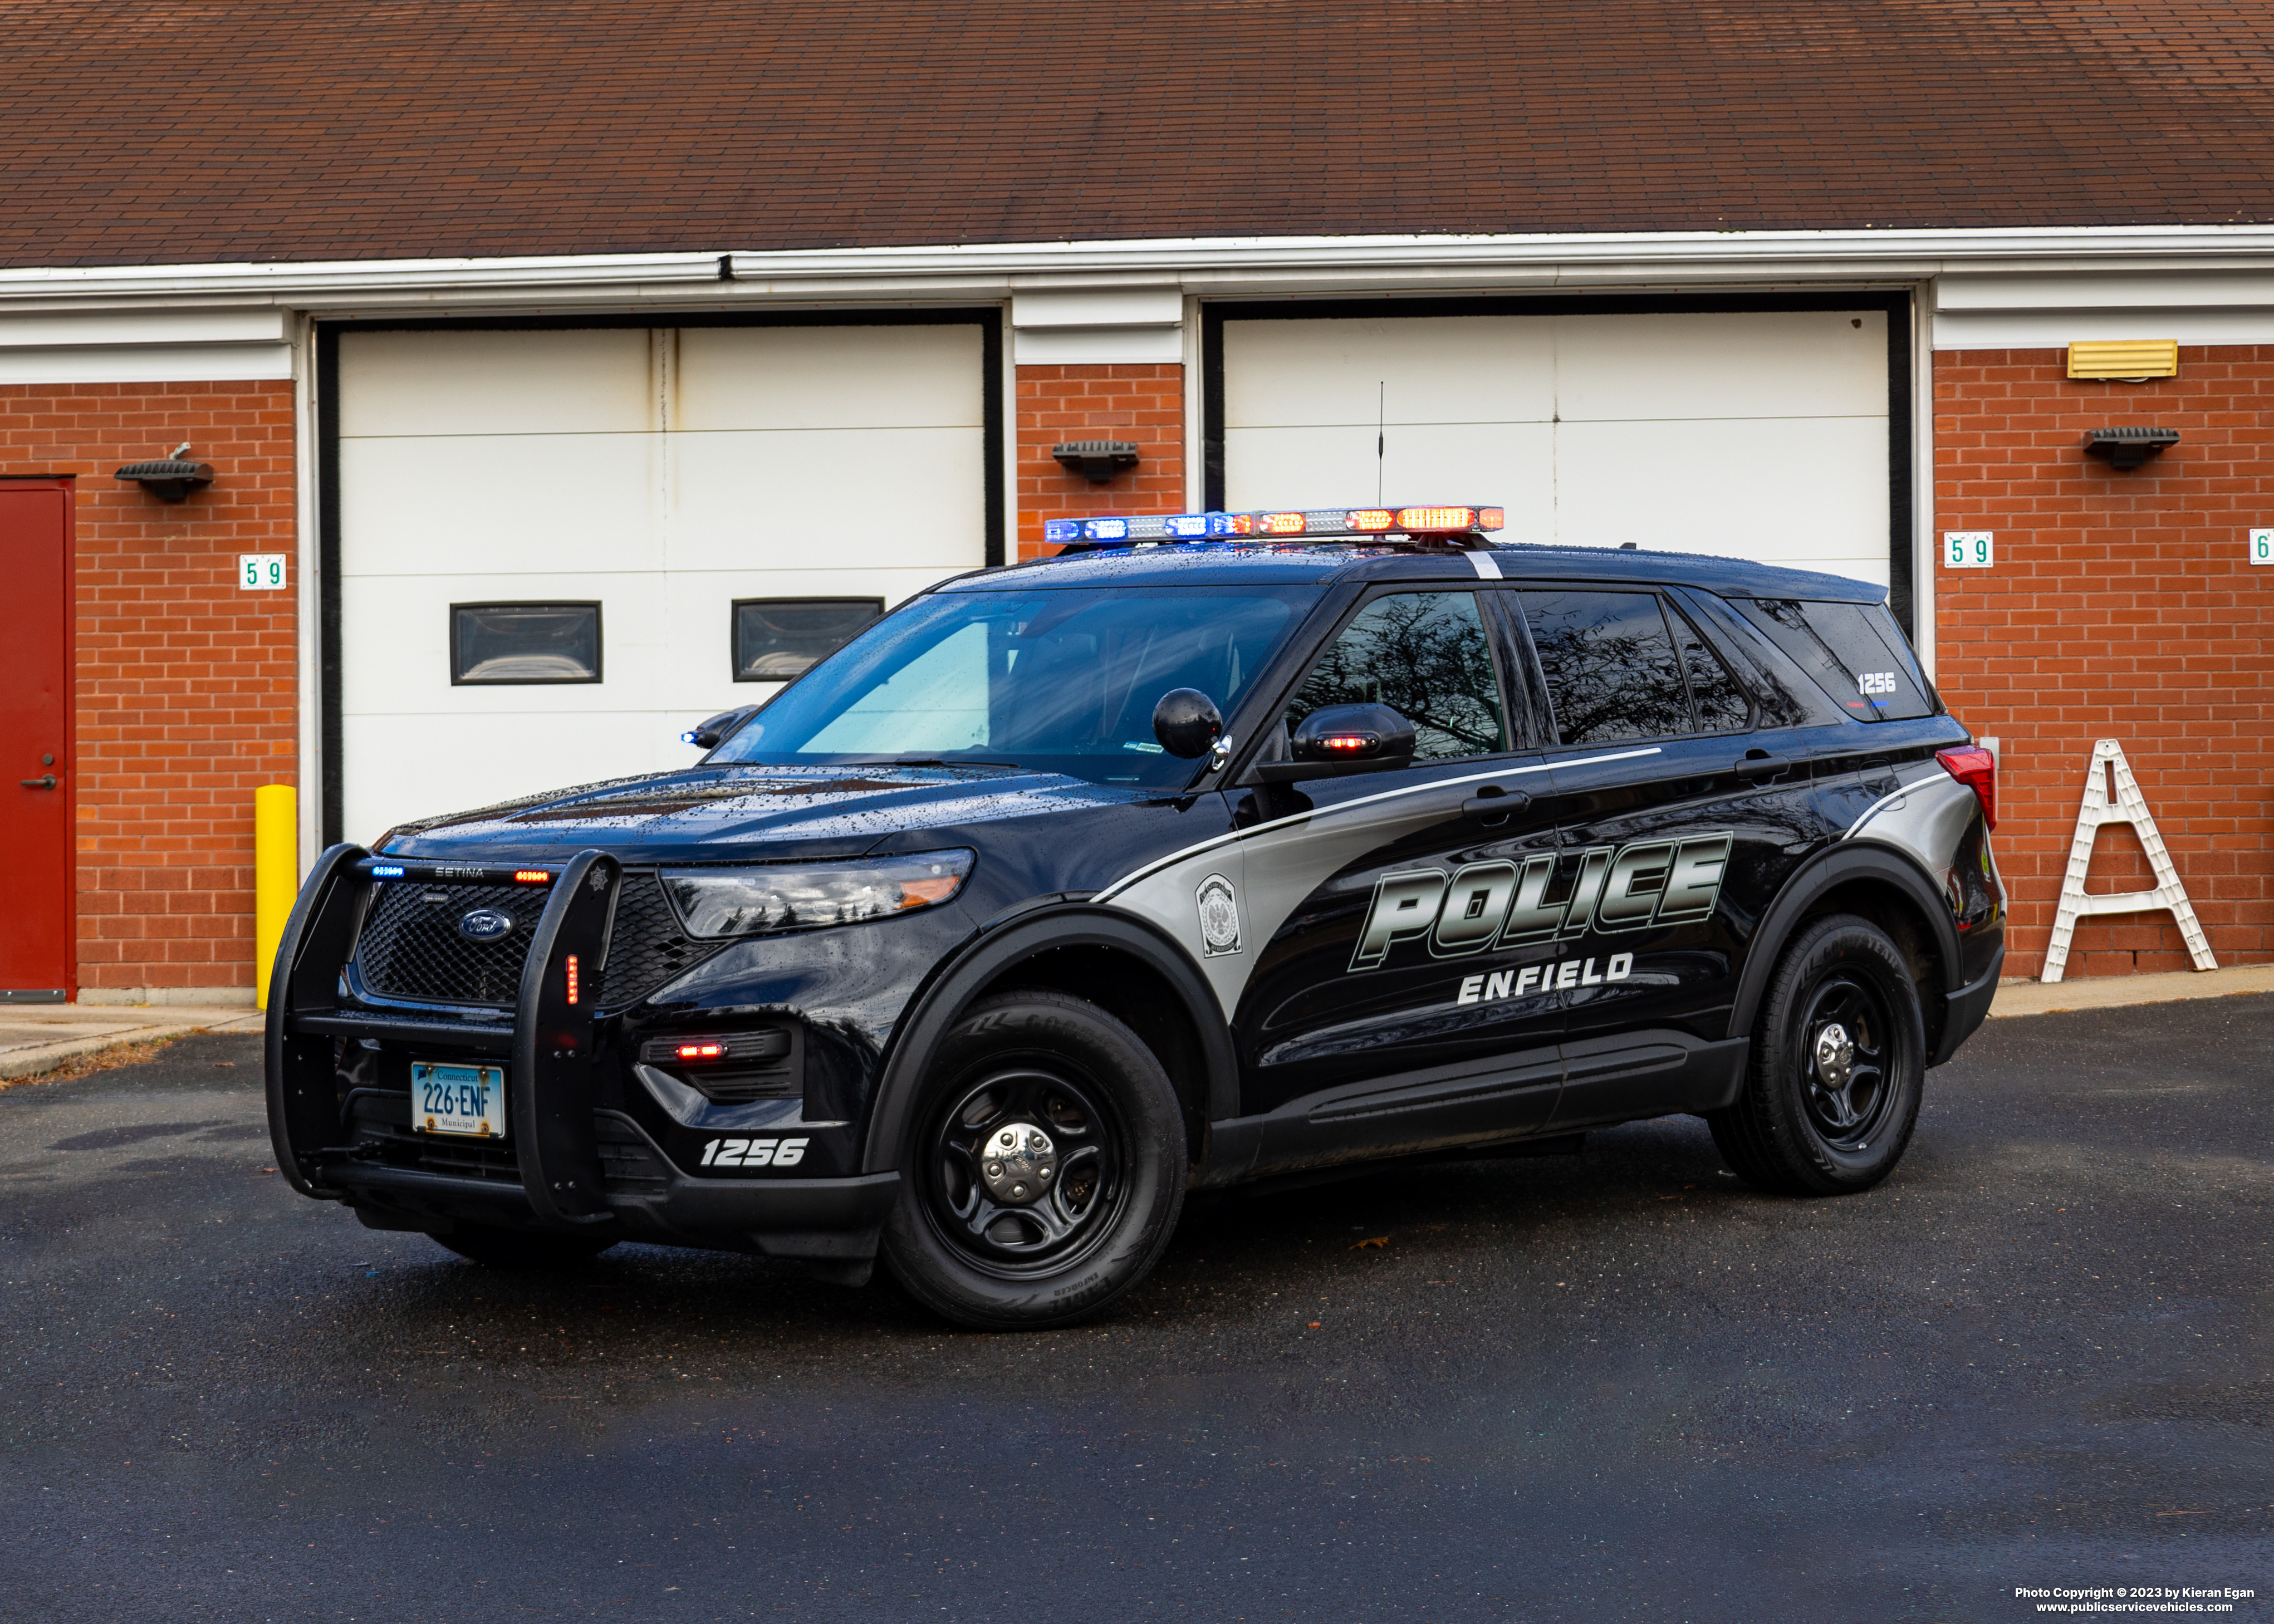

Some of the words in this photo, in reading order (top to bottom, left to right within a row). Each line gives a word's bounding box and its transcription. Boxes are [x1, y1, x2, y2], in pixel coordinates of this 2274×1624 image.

[2258, 535, 2269, 558] 6
[1858, 671, 1896, 695] 1256
[435, 867, 484, 878] SETINA
[1347, 831, 1733, 972] POLICE
[468, 916, 497, 933] Ford
[1457, 953, 1634, 1005] ENFIELD
[437, 1070, 478, 1082] Connecticut
[442, 1117, 476, 1129] Municipal
[700, 1138, 810, 1167] 1256
[1053, 1272, 1100, 1297] ENFORCER
